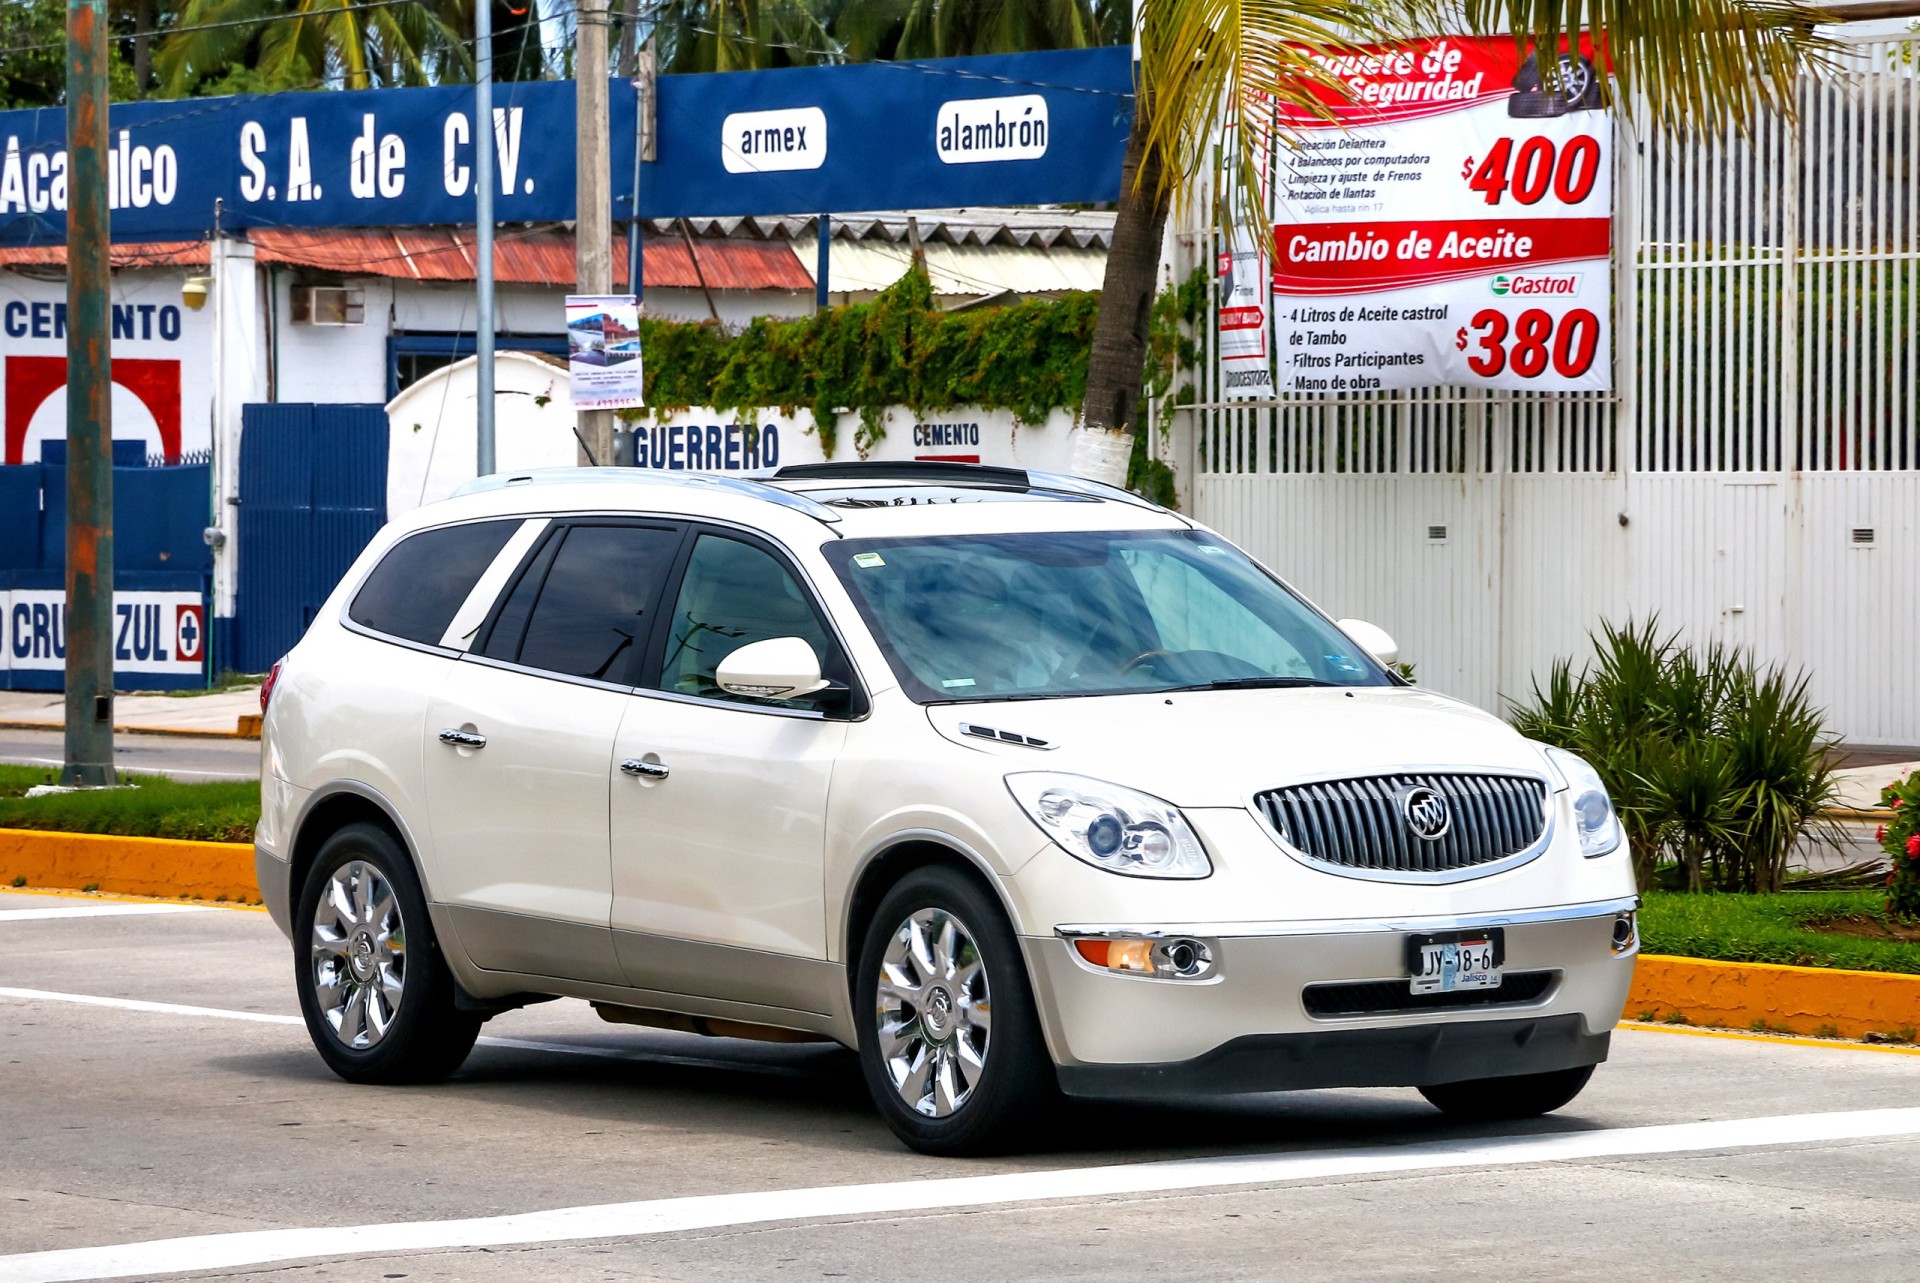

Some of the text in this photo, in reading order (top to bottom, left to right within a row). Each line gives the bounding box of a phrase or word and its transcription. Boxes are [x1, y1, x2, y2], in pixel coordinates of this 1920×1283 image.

[1421, 41, 1462, 74] de
[1347, 72, 1484, 108] Seguridad
[741, 126, 807, 154] armex
[940, 107, 1045, 151] alambrón
[1338, 138, 1386, 149] Delantera
[0, 130, 178, 214] Acalco
[350, 113, 406, 198] de
[1289, 153, 1431, 168] 4 Balanceos por computadora
[1461, 134, 1600, 205] $400
[1288, 170, 1422, 186] Limpieza y ajuste de Frenos
[1287, 188, 1376, 200] Rotación de llantas
[1304, 203, 1384, 214] Aplica hasta rin 17
[1288, 229, 1533, 262] Cambio de Aceite
[1511, 276, 1576, 295] Castrol
[5, 301, 181, 342] CENTO
[1290, 304, 1449, 322] 4 Litros de Aceite castrol
[1289, 330, 1347, 345] de Tambo
[1456, 308, 1600, 378] $380
[1293, 351, 1425, 369] Filtros Participantes
[1295, 375, 1381, 390] Mano de obra
[633, 423, 779, 470] GUERRERO
[913, 423, 979, 447] CEMENTO
[12, 603, 168, 661] CRU ZUL
[1461, 972, 1487, 983] Jalisco
